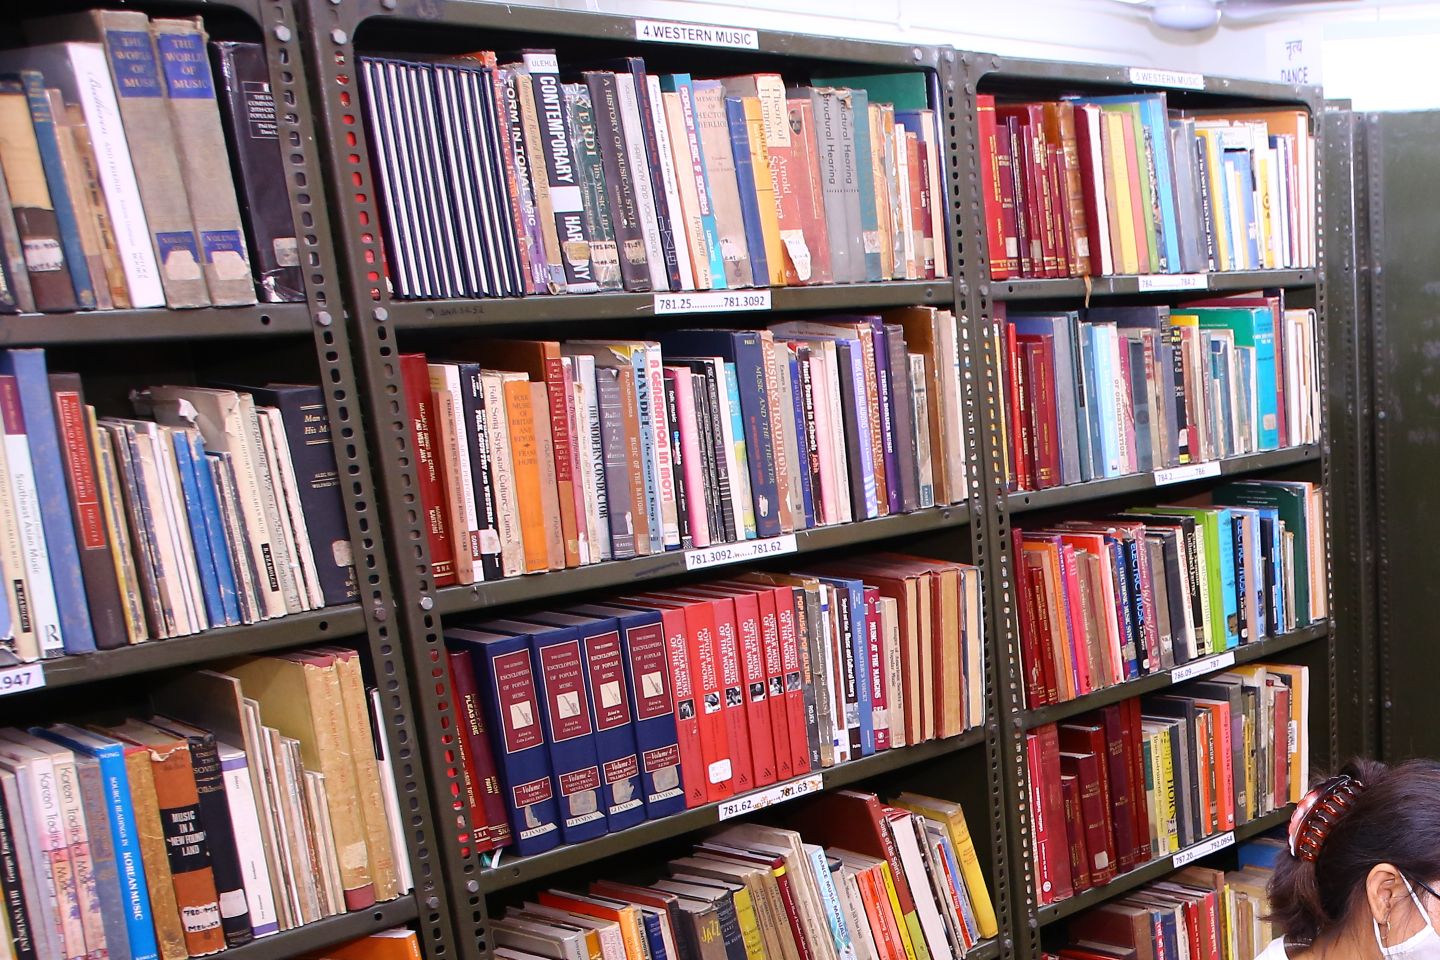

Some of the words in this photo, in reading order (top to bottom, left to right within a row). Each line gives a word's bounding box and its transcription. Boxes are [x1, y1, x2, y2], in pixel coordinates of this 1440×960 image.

[715, 32, 753, 46] MUSIC
[1177, 75, 1201, 87] MUSIC
[1280, 67, 1309, 84] DANCE
[505, 77, 520, 122] FORM
[605, 89, 620, 132] HISTORY
[576, 96, 597, 156] VERDI
[822, 93, 836, 141] Structural
[512, 127, 523, 142] IN
[540, 76, 574, 184] CONTEMPORARY
[613, 137, 623, 149] OF
[515, 146, 530, 196] TONAL
[616, 152, 630, 197] MUSICAL
[778, 155, 791, 194] Arnold
[826, 144, 838, 185] Hearing
[842, 143, 854, 184] Hearing
[625, 200, 636, 229] STYLE
[660, 298, 692, 310] 781.25
[723, 295, 766, 308] 781.3092
[650, 359, 661, 369] A
[802, 360, 812, 384] Music
[754, 364, 765, 393] MUSIC
[880, 370, 889, 395] ETHNIC
[488, 385, 498, 406] Folk
[636, 367, 649, 429] HANDEL
[804, 384, 814, 411] Drama
[864, 336, 877, 378] MUSIC
[871, 393, 884, 464] TRADITION
[489, 407, 502, 431] Song
[588, 405, 598, 420] THE
[651, 371, 669, 448] GENERATION
[759, 397, 768, 418] AND
[764, 343, 778, 388] MUSIC
[772, 402, 787, 476] TRADITION
[807, 411, 815, 420] in
[883, 403, 891, 431] BORDER
[475, 409, 484, 432] FOLK
[762, 421, 770, 440] THE
[492, 431, 505, 454] Style
[590, 421, 602, 460] MODERN
[630, 438, 639, 457] MUSIC
[808, 421, 818, 451] Schools
[885, 432, 893, 453] MUSIC
[418, 448, 427, 463] JAVA
[478, 433, 488, 470] COUNTRY
[658, 451, 670, 466] IN
[496, 456, 507, 473] and
[633, 460, 640, 469] OF
[764, 443, 775, 485] THEATER
[811, 453, 819, 474] John
[634, 471, 642, 485] THE
[15, 473, 32, 519] Southeast
[592, 461, 607, 520] CONDUCTOR
[636, 488, 644, 516] NATIONS
[484, 485, 494, 523] WESTERN
[22, 520, 35, 546] Asian
[502, 514, 514, 544] Lomax
[470, 534, 478, 557] GORDON
[690, 549, 732, 566] 781.3092
[751, 541, 782, 555] 781.62
[26, 548, 41, 574] Music
[796, 595, 804, 610] POP
[742, 621, 750, 631] OF
[763, 616, 771, 626] OF
[780, 612, 787, 623] OF
[798, 609, 807, 637] MUSIC,
[1124, 605, 1132, 625] MUSIC
[696, 630, 704, 640] OF
[718, 625, 726, 635] OF
[747, 618, 757, 657] POPULAR
[764, 628, 772, 645] THE
[767, 613, 776, 652] POPULAR
[781, 624, 789, 641] THE
[785, 609, 793, 648] POPULAR
[844, 632, 853, 648] Music
[869, 621, 878, 642] MUSIC
[669, 637, 678, 647] OF
[675, 633, 684, 671] POPULAR
[698, 643, 706, 660] THE
[701, 628, 710, 666] POPULAR
[720, 638, 728, 655] THE
[723, 623, 733, 661] POPULAR
[728, 663, 737, 684] MUSIC
[744, 634, 752, 651] THE
[871, 643, 879, 653] AT
[671, 649, 680, 666] THE
[746, 651, 755, 680] WORLD
[766, 646, 775, 674] WORLD
[770, 652, 780, 673] MUSIC
[782, 641, 792, 670] WORLD
[787, 648, 796, 669] MUSIC
[802, 649, 812, 685] CULTURE
[871, 653, 879, 666] THE
[700, 661, 709, 691] WORLD
[705, 669, 714, 689] MUSIC
[722, 656, 731, 685] WORLD
[751, 659, 760, 679] MUSIC
[847, 658, 855, 680] Cultural
[673, 667, 683, 698] WORLD
[678, 674, 687, 696] MUSIC
[847, 679, 856, 698] Theory
[872, 666, 881, 699] MARGINS
[464, 694, 479, 736] PLEASURE
[807, 704, 815, 724] ROJEK
[39, 772, 53, 809] Korean
[61, 767, 75, 804] Korean
[109, 776, 121, 804] SOURCE
[172, 811, 196, 823] MUSIC
[722, 801, 752, 815] 781.62
[113, 804, 127, 838] READINGS
[179, 824, 187, 833] IN
[188, 823, 195, 832] A
[878, 818, 888, 837] Song
[121, 839, 129, 847] IN
[182, 845, 200, 857] LAND
[883, 838, 890, 846] of
[886, 846, 894, 857] the
[1175, 852, 1194, 865] 787.20
[122, 851, 139, 891] KOREAN
[130, 889, 143, 920] MUSIC
[817, 854, 828, 879] DANCE
[825, 880, 836, 904] MUSIC
[833, 904, 847, 940] MANUAL
[701, 919, 721, 944] JAZZ
